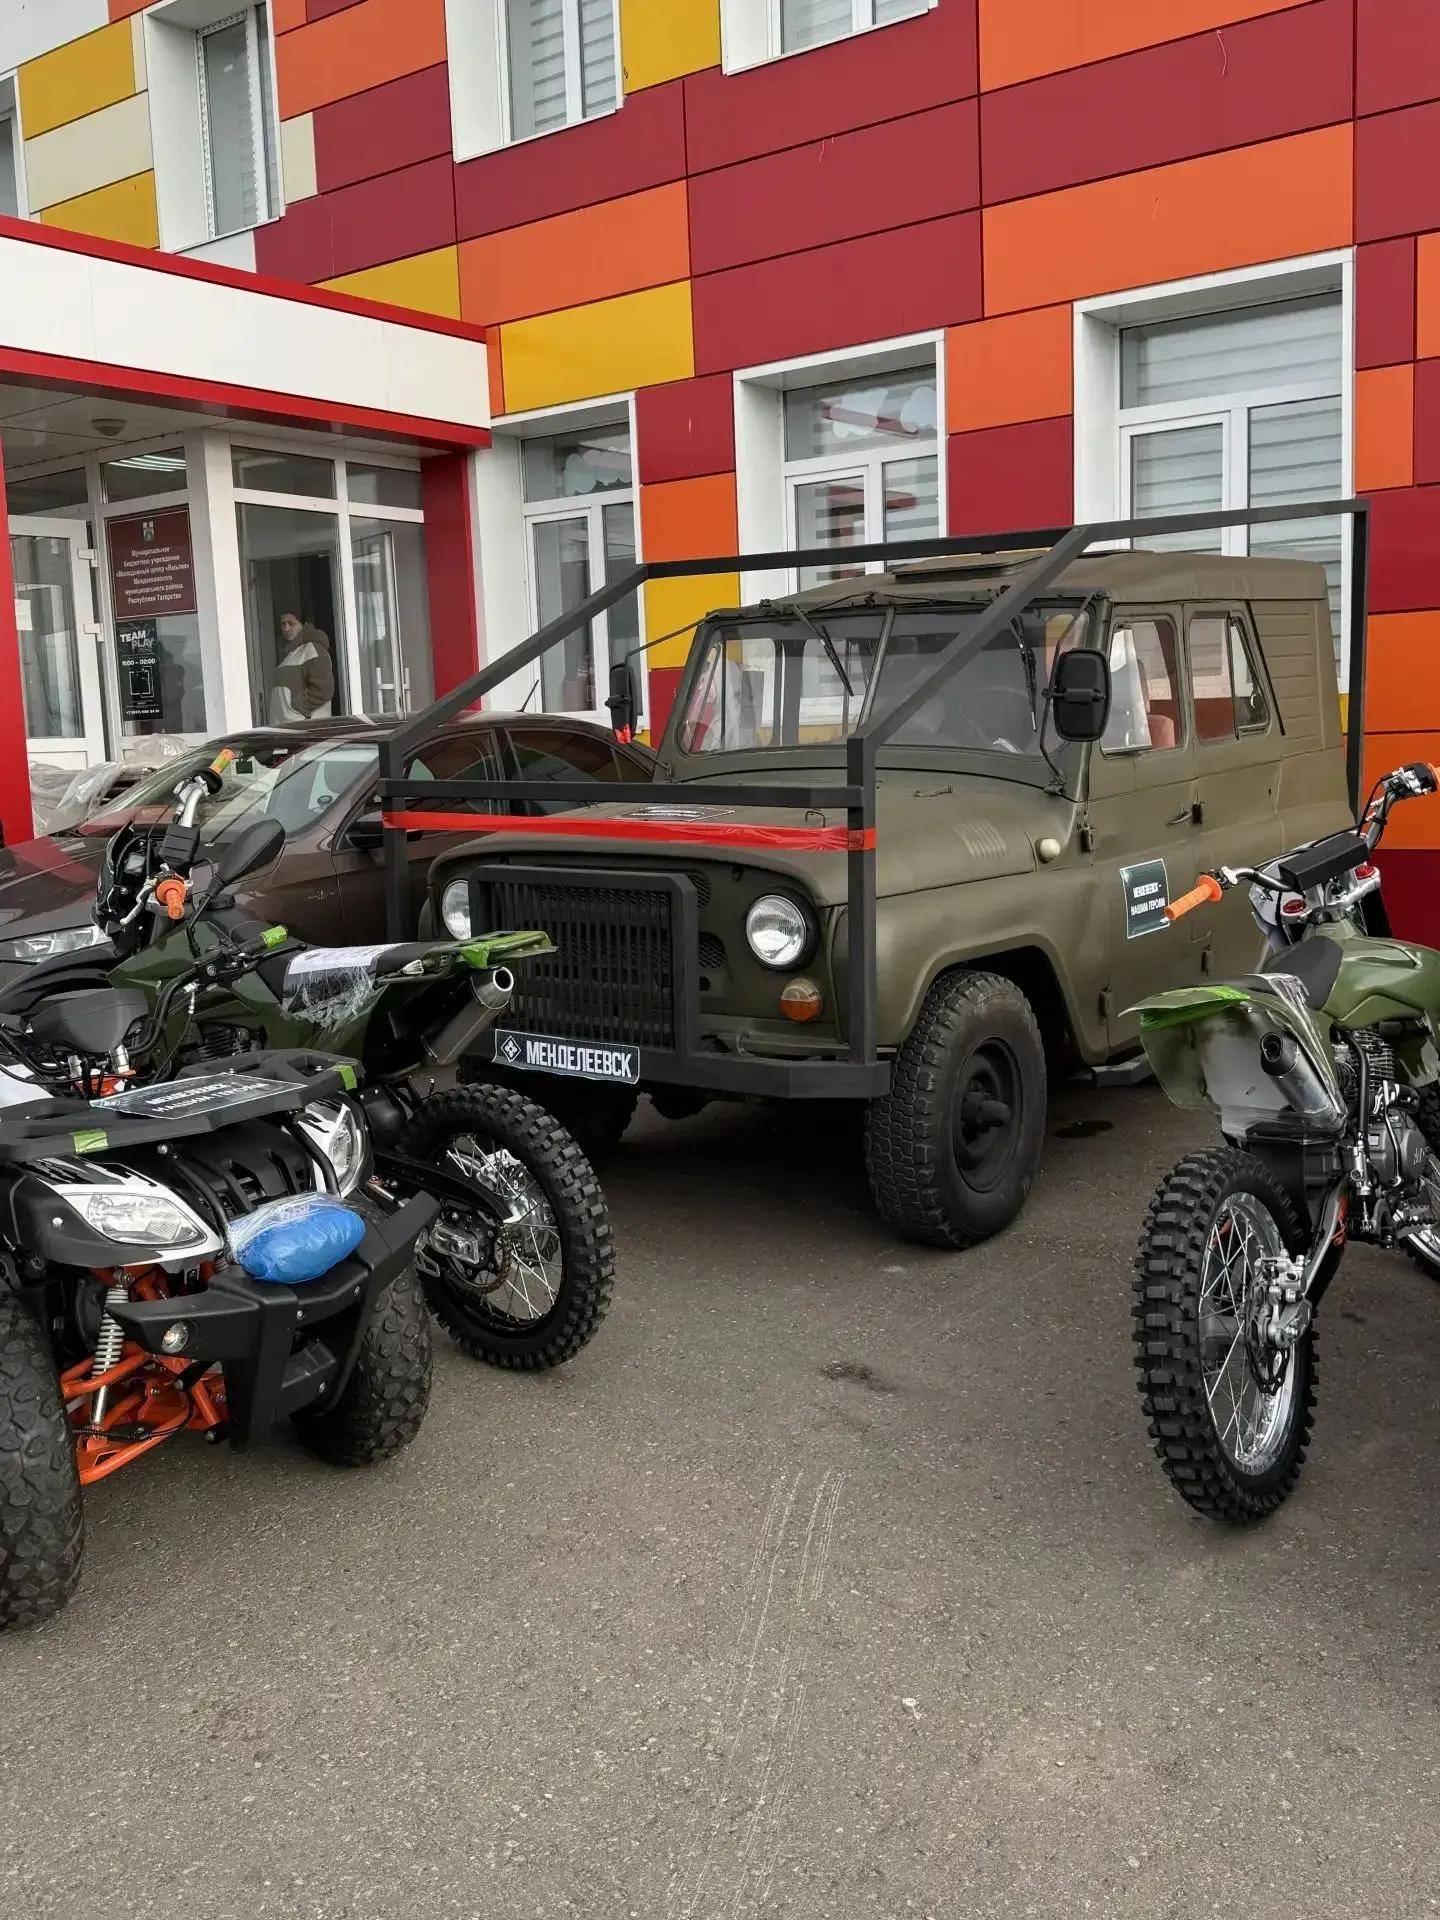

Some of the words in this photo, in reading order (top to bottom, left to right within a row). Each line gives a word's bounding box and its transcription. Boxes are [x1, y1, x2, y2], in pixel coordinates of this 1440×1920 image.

[119, 630, 146, 643] TEAM
[131, 638, 154, 649] PLAY
[526, 1040, 632, 1078] МЕНДЕЛЕЕВСК
